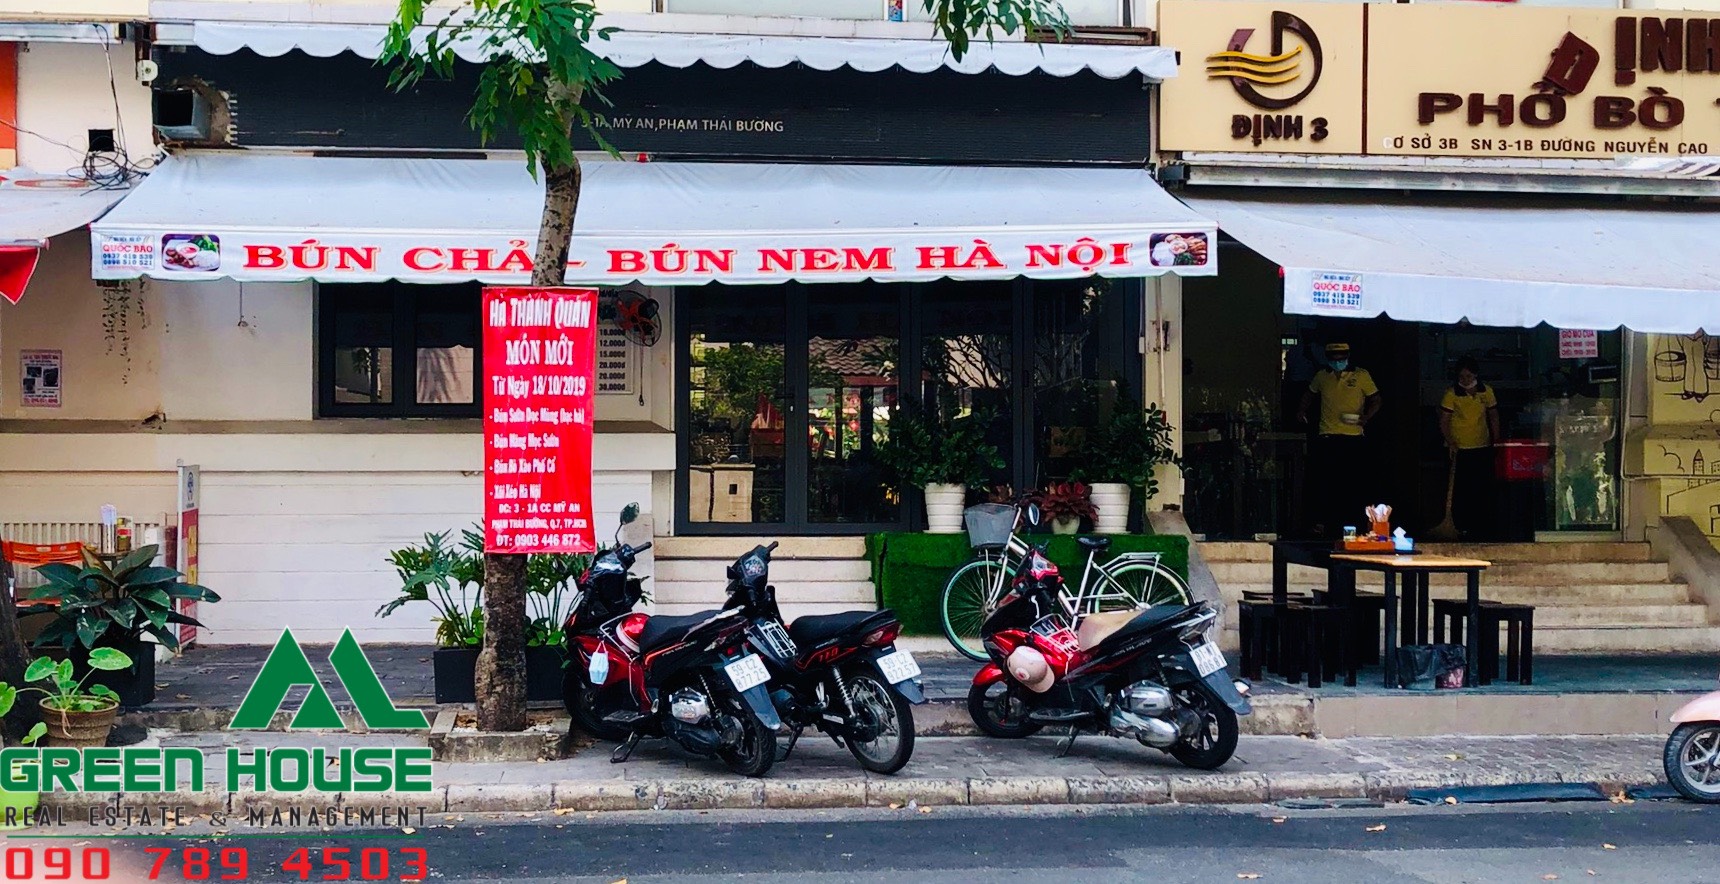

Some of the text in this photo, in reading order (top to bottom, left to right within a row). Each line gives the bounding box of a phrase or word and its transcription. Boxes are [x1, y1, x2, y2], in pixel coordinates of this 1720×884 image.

[1418, 79, 1685, 129] PHỔ BÒ
[702, 114, 732, 131] THÁI
[736, 115, 784, 132] BƯỜNG
[1231, 115, 1329, 147] ĐỊNH 3
[1411, 133, 1432, 150] SỞ
[1438, 138, 1458, 150] 3B
[1471, 138, 1492, 151] SN
[1498, 139, 1533, 151] 3-1B
[1540, 136, 1595, 152] ĐƯỜNG
[1604, 136, 1669, 154] NGUYỄN
[1678, 142, 1708, 155] CAO
[242, 239, 381, 271] BÚN
[403, 239, 534, 273] CHẢ
[606, 243, 736, 275] BÚN
[759, 247, 897, 274] NEM
[915, 238, 1009, 272] HÀ
[1025, 236, 1133, 275] NỘI
[489, 293, 592, 330] HÀ THÀNH QUÁN
[505, 333, 574, 366] MÓN MỚI
[492, 374, 587, 399] Từ Ngày 18/10/2019
[513, 503, 520, 513] 3
[527, 503, 538, 513] 1A
[540, 503, 552, 513] CC
[553, 500, 567, 513] MỸ
[568, 503, 580, 513] AN
[495, 533, 581, 547] ĐT: 0903 446 872
